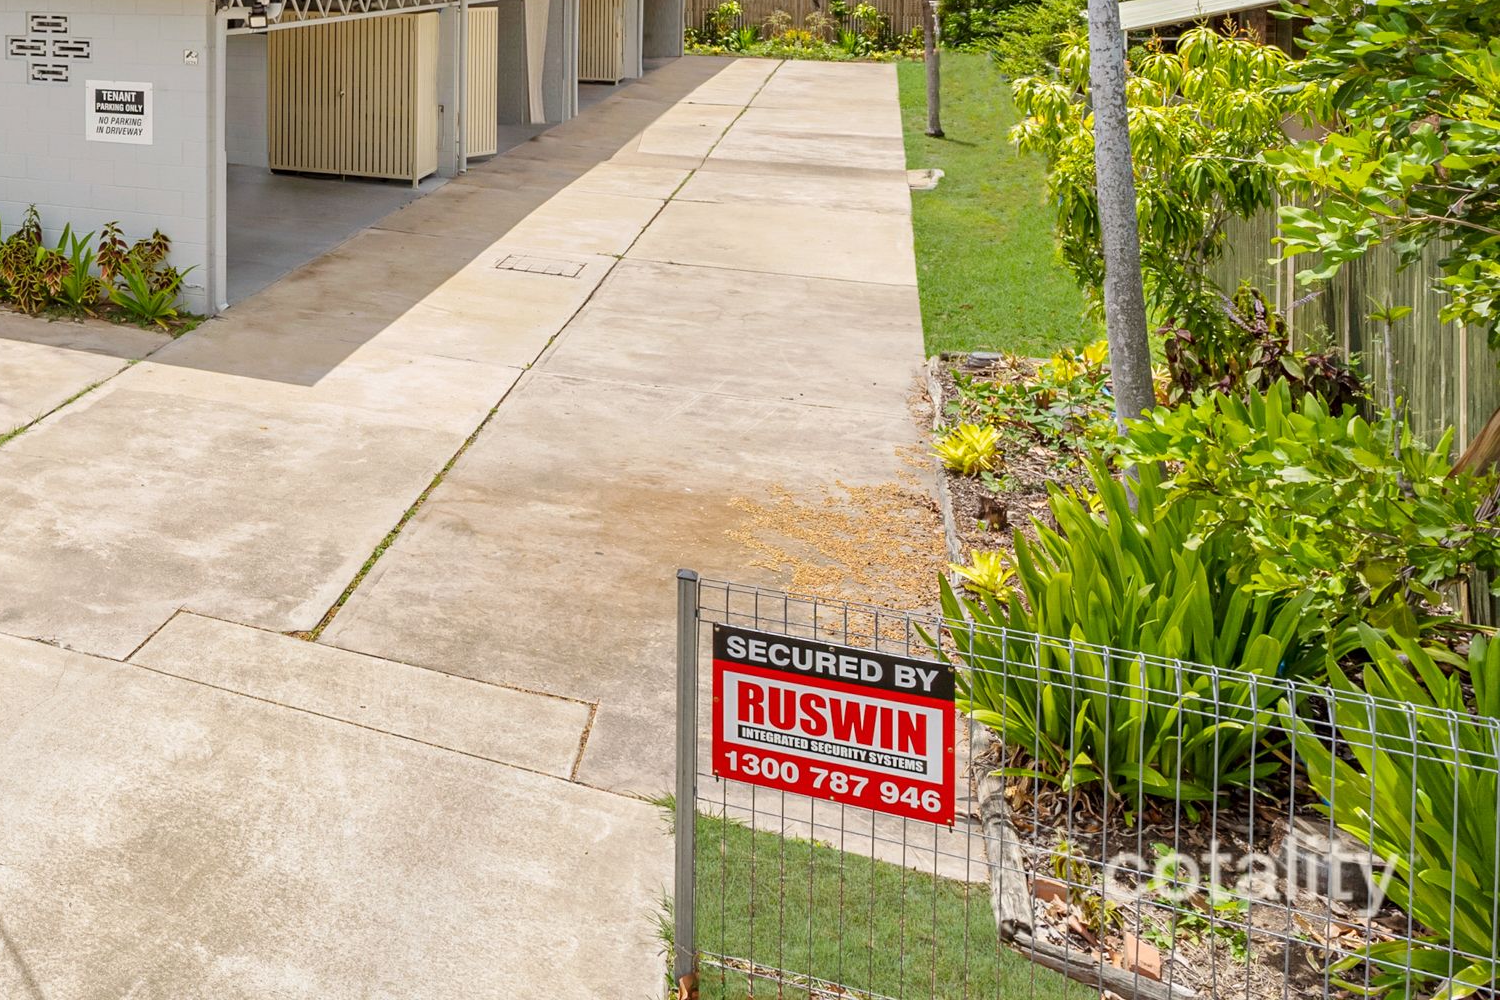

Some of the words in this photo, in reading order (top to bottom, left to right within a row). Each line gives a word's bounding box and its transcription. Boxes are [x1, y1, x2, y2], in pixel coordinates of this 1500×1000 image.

[96, 103, 124, 111] PARKING
[125, 104, 143, 113] ONLY
[102, 91, 136, 102] TENANT
[96, 126, 104, 134] IN
[105, 126, 143, 136] DRIVEWAY
[98, 116, 109, 125] NO
[110, 117, 142, 126] PARKING
[726, 635, 883, 682] SECURED
[894, 664, 940, 692] BY
[737, 680, 927, 756] RUSWIN
[741, 727, 809, 750] INTEGRATED
[810, 740, 868, 761] SECURITY
[868, 752, 924, 772] SYSTEMS
[724, 750, 799, 784] 1300
[809, 766, 869, 797] 787
[879, 781, 942, 813] 946
